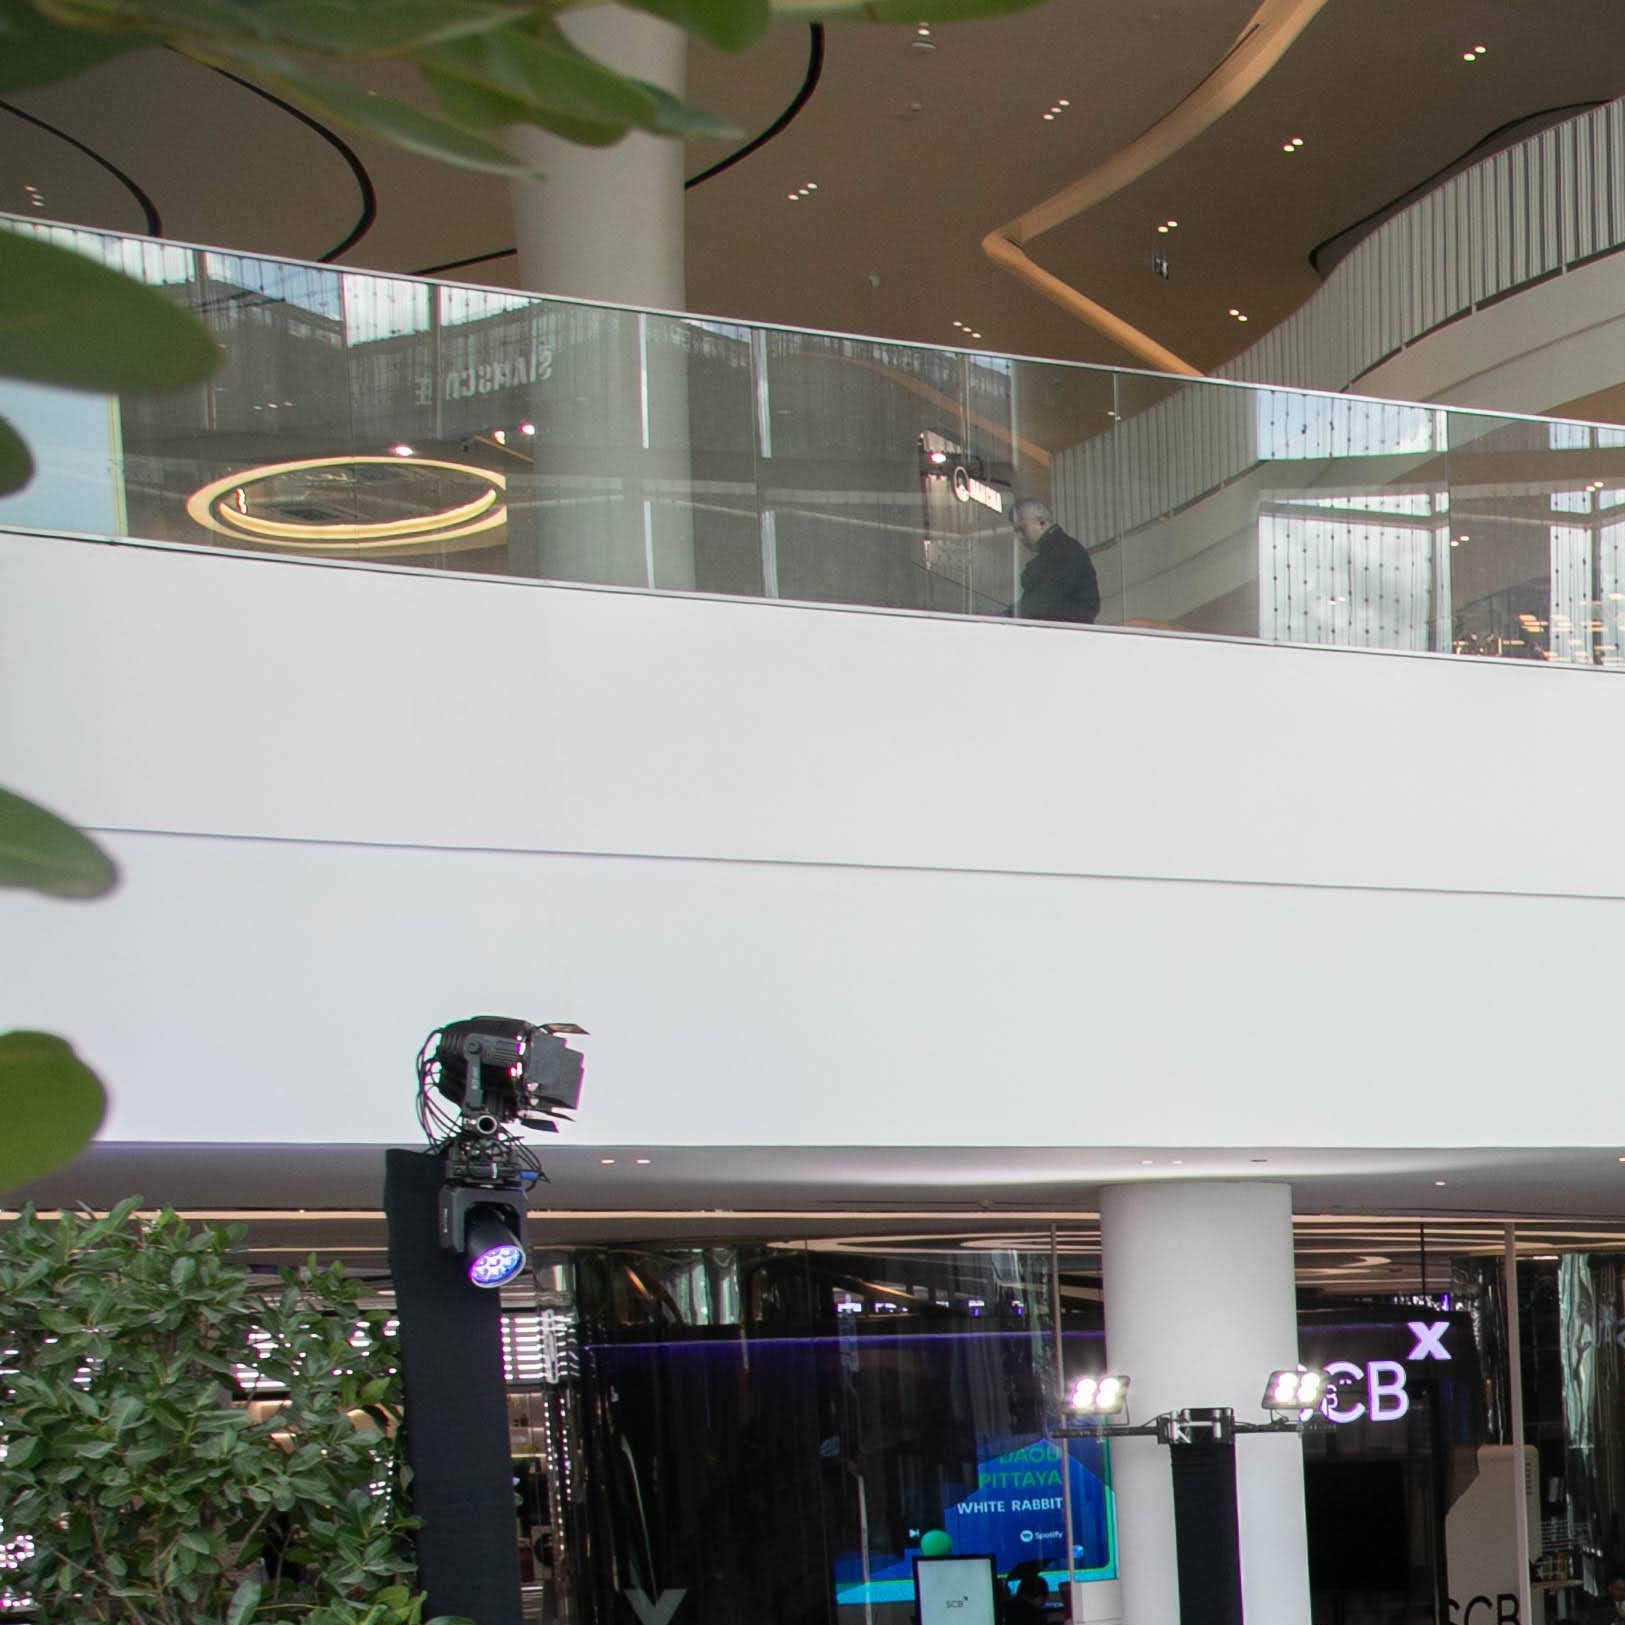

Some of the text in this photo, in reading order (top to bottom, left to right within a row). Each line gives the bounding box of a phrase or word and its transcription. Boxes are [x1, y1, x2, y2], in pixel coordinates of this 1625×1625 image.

[978, 1470, 1062, 1489] PITTAYA
[957, 1497, 1063, 1515] WHITE RABBIT
[1035, 1530, 1063, 1540] Spotify
